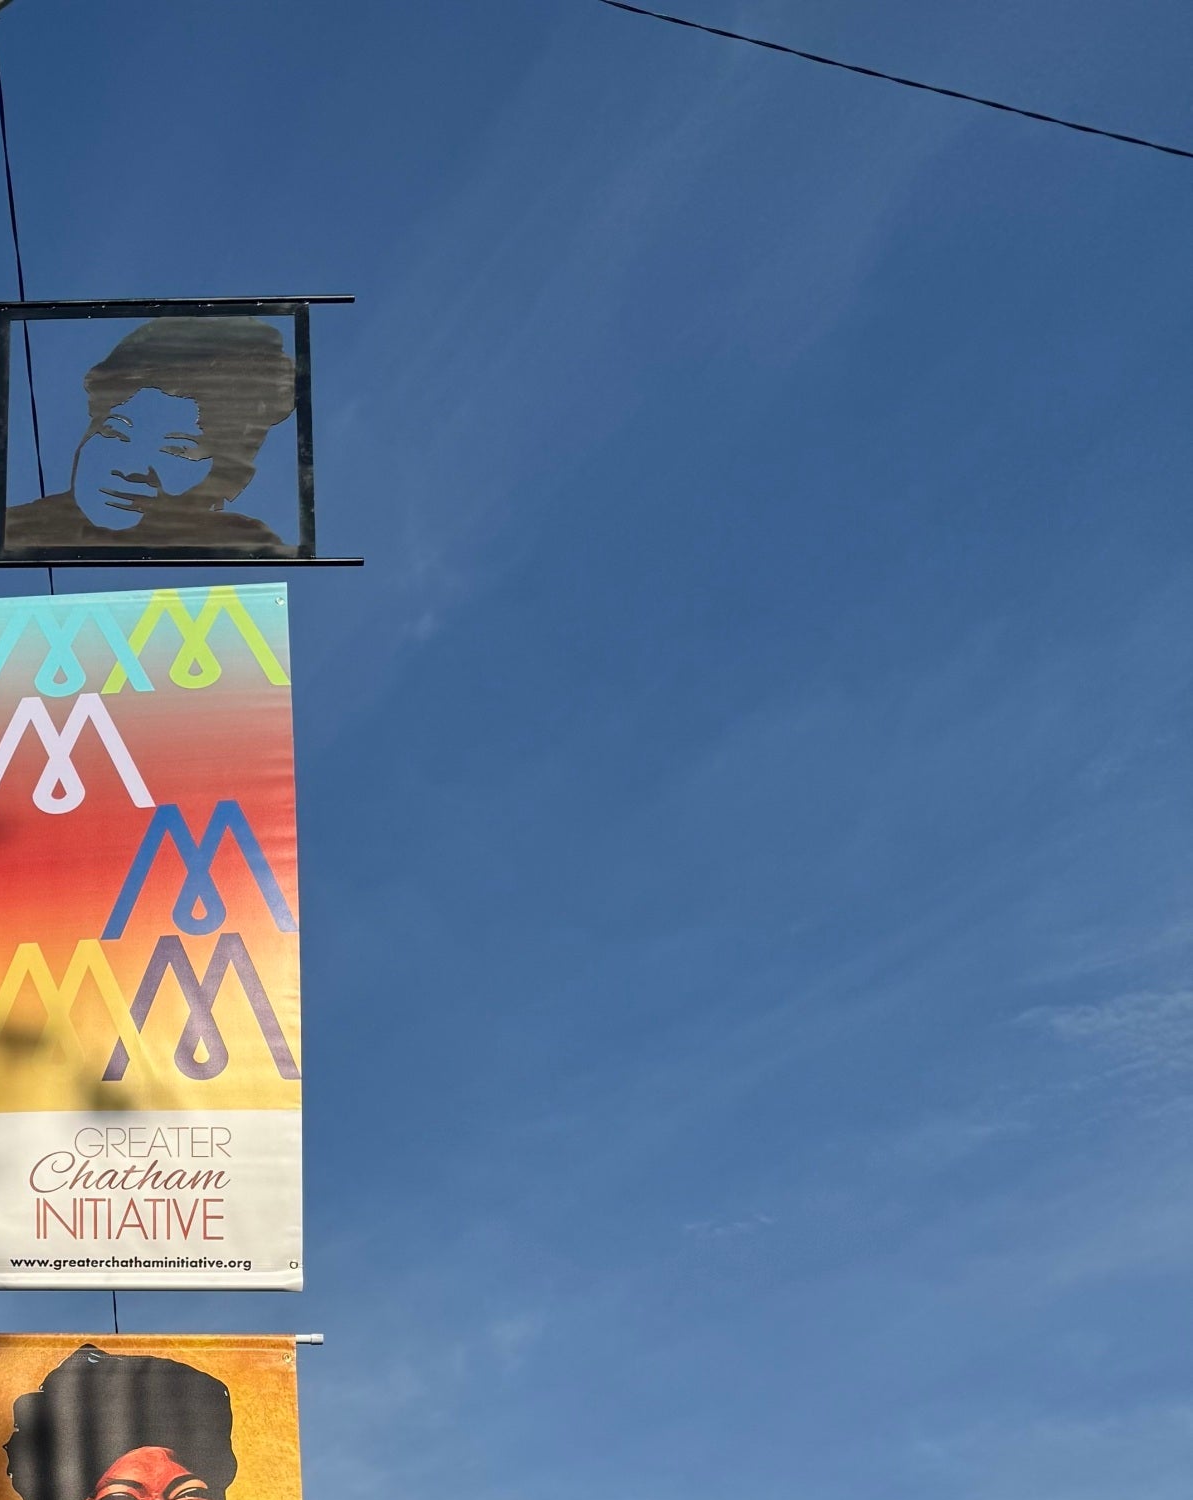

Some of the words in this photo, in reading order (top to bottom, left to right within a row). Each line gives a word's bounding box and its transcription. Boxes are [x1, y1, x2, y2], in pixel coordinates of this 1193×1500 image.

[74, 1127, 232, 1158] GREATER
[29, 1151, 231, 1193] Chatham
[36, 1198, 224, 1240] INITIATIVE
[10, 1256, 252, 1271] www.greaterchathaminitiative.org
